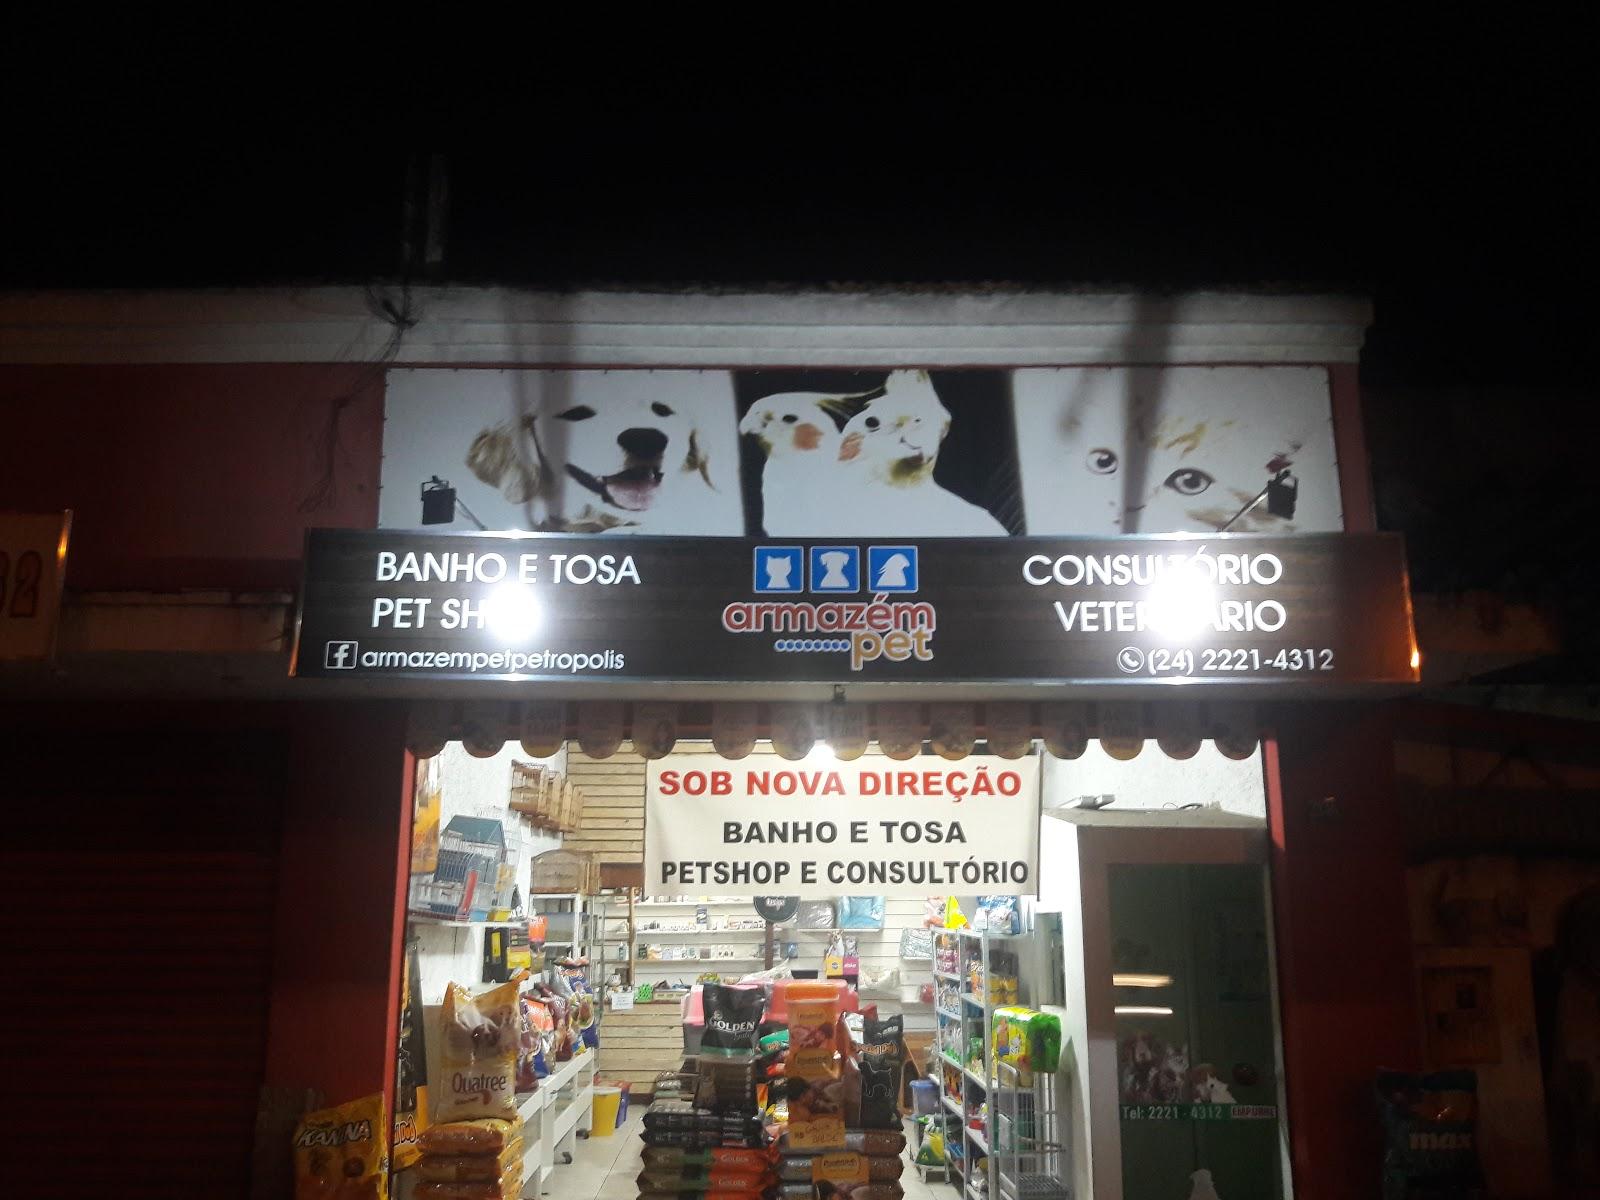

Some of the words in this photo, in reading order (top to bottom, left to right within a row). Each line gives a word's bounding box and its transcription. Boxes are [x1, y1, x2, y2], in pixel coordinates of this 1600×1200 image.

[377, 551, 508, 584] BANHO
[518, 553, 538, 584] E
[549, 554, 642, 585] TOSA
[371, 597, 432, 629] PET
[722, 591, 937, 633] armazém
[361, 649, 626, 674] armazempetpetropolis
[851, 625, 935, 671] pet
[1147, 649, 1195, 676] (24)
[1201, 649, 1336, 672] 2221-4312
[659, 769, 734, 797] SOB
[746, 770, 847, 797] NOVA
[859, 765, 1022, 804] DIREÇÃO
[722, 820, 839, 845] BANHO
[849, 820, 868, 844] E
[879, 820, 968, 845] TOSA
[660, 860, 792, 885] PETSHOP
[800, 860, 818, 885] E
[826, 855, 1030, 886] CONSULTÓRIO
[452, 1071, 507, 1093] Quatree
[1121, 1105, 1145, 1119] Tel:
[1148, 1106, 1179, 1119] 2221
[1191, 1106, 1223, 1119] 4312
